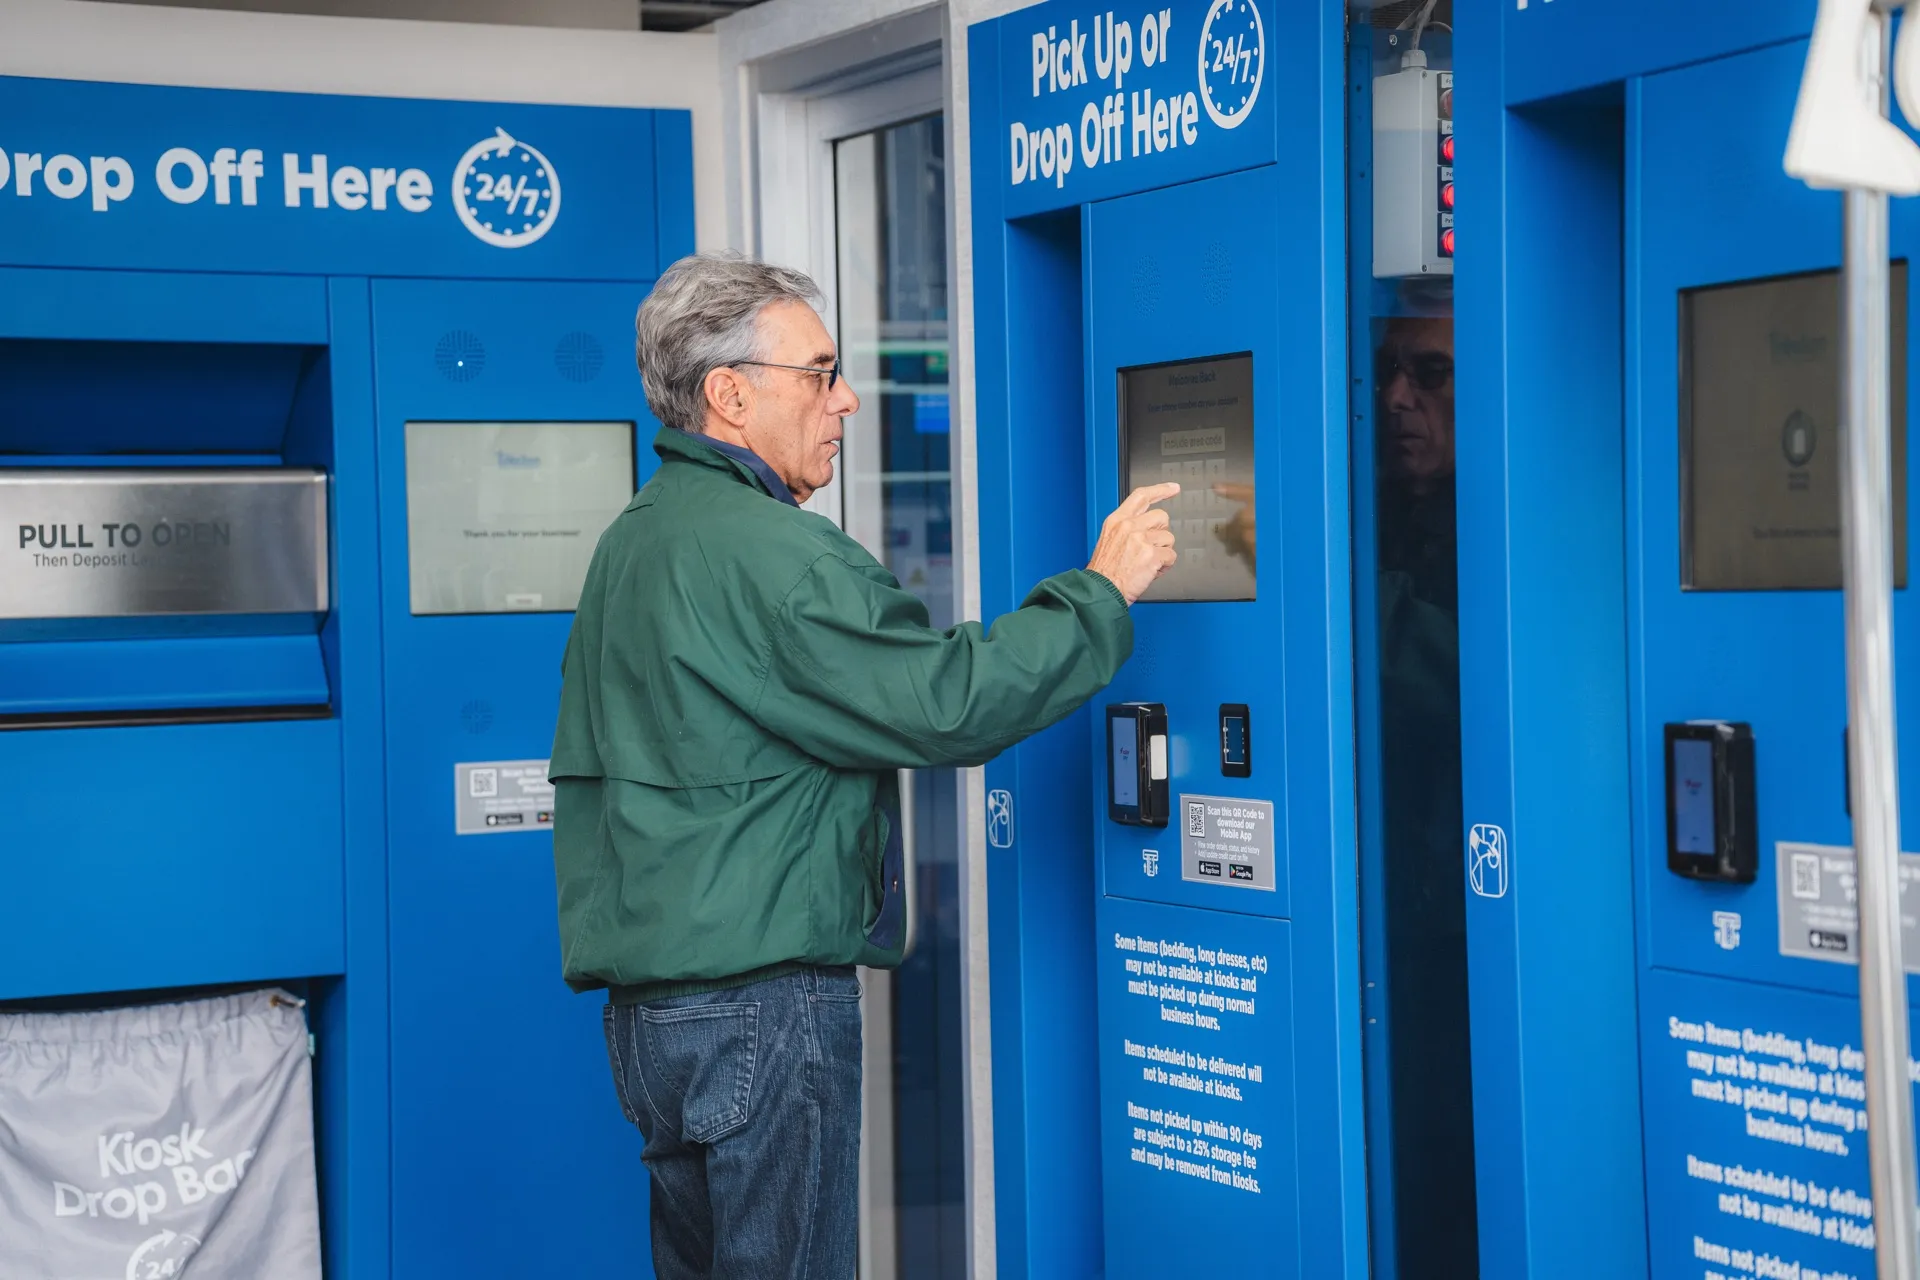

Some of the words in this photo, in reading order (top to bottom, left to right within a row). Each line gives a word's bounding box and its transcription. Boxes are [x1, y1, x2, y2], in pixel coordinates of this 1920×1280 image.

[1032, 19, 1088, 97] Pick
[1094, 11, 1133, 89] Up
[1140, 8, 1171, 67] or
[1212, 33, 1251, 85] 24/7
[1010, 122, 1073, 189] Drop
[1080, 92, 1124, 169] Off
[1132, 88, 1199, 157] Here
[0, 147, 134, 211] rop
[155, 147, 264, 205] Off
[282, 153, 433, 213] Here
[476, 172, 539, 216] 24/7
[19, 524, 94, 548] PULL
[102, 523, 142, 548] TO
[152, 522, 231, 548] OPEN
[33, 553, 68, 567] Then
[72, 552, 126, 568] Deposit
[1208, 806, 1220, 816] Scan
[1222, 806, 1232, 817] this
[1233, 808, 1241, 818] QR
[1242, 808, 1257, 820] Code
[1258, 810, 1264, 820] to
[1216, 817, 1244, 828] download
[1245, 822, 1255, 830] our
[1220, 828, 1238, 839] Mobile
[1240, 830, 1252, 842] App
[1114, 933, 1136, 951] Some
[1137, 936, 1158, 954] items
[1160, 939, 1196, 964] (bedding,
[1198, 944, 1216, 966] long
[1217, 948, 1250, 972] dresses,
[1252, 956, 1268, 974] etc)
[1126, 958, 1140, 976] may
[1143, 961, 1156, 976] not
[1158, 962, 1167, 978] be
[1169, 964, 1202, 984] available
[1204, 972, 1213, 984] at
[1214, 970, 1240, 990] kiosks
[1240, 976, 1256, 992] and
[1128, 980, 1148, 994] must
[1148, 980, 1158, 998] be
[1160, 983, 1185, 1002] picked
[1186, 991, 1198, 1006] up
[1199, 989, 1224, 1012] during
[1226, 998, 1254, 1014] normal
[1161, 1004, 1194, 1026] business
[1196, 1011, 1220, 1030] hours.
[1124, 1039, 1146, 1058] Items
[1146, 1044, 1185, 1067] scheduled
[1187, 1052, 1196, 1068] to
[1196, 1053, 1207, 1072] be
[1209, 1056, 1246, 1080] delivered
[1248, 1066, 1262, 1083] will
[1668, 1016, 1704, 1042] Some
[1705, 1020, 1741, 1049] items
[1806, 1038, 1838, 1071] long
[1144, 1068, 1156, 1082] not
[1158, 1066, 1168, 1084] be
[1169, 1072, 1204, 1092] available
[1205, 1079, 1214, 1095] at
[1215, 1080, 1242, 1101] kiosks.
[1686, 1050, 1714, 1076] may
[1716, 1055, 1738, 1077] not
[1739, 1054, 1757, 1080] be
[1758, 1062, 1817, 1092] available
[1818, 1072, 1834, 1096] at
[1834, 1071, 1866, 1102] kios
[1128, 1100, 1148, 1121] Items
[1150, 1108, 1163, 1124] not
[1164, 1110, 1190, 1131] picked
[1192, 1120, 1202, 1136] up
[1204, 1120, 1228, 1140] within
[1230, 1126, 1240, 1143] 90
[1242, 1128, 1262, 1150] days
[1692, 1078, 1724, 1102] must
[1724, 1080, 1742, 1105] be
[1744, 1086, 1788, 1114] picked
[1789, 1096, 1808, 1122] up
[1809, 1096, 1855, 1132] during
[98, 1122, 214, 1178] Kiosk
[1134, 1127, 1146, 1142] are
[1148, 1130, 1175, 1150] subject
[1176, 1135, 1185, 1152] to
[1186, 1142, 1192, 1154] a
[1193, 1138, 1210, 1158] 25%
[1211, 1146, 1242, 1168] storage
[1243, 1151, 1256, 1170] fee
[1746, 1112, 1803, 1146] business
[1804, 1124, 1848, 1156] hours.
[1131, 1148, 1146, 1164] and
[1147, 1152, 1163, 1170] may
[1164, 1152, 1174, 1170] be
[1176, 1160, 1210, 1180] removed
[1212, 1166, 1231, 1186] from
[1232, 1171, 1260, 1194] kiosks.
[1686, 1154, 1722, 1184] Items
[1724, 1164, 1790, 1200] scheduled
[1792, 1178, 1808, 1204] to
[1808, 1180, 1828, 1208] be
[1828, 1186, 1872, 1220] delive
[54, 1181, 167, 1225] Drop
[1718, 1193, 1742, 1216] not
[1742, 1194, 1760, 1220] be
[1762, 1202, 1822, 1236] available
[1823, 1216, 1840, 1240] at
[1694, 1235, 1730, 1266] Items
[1731, 1248, 1754, 1273] not
